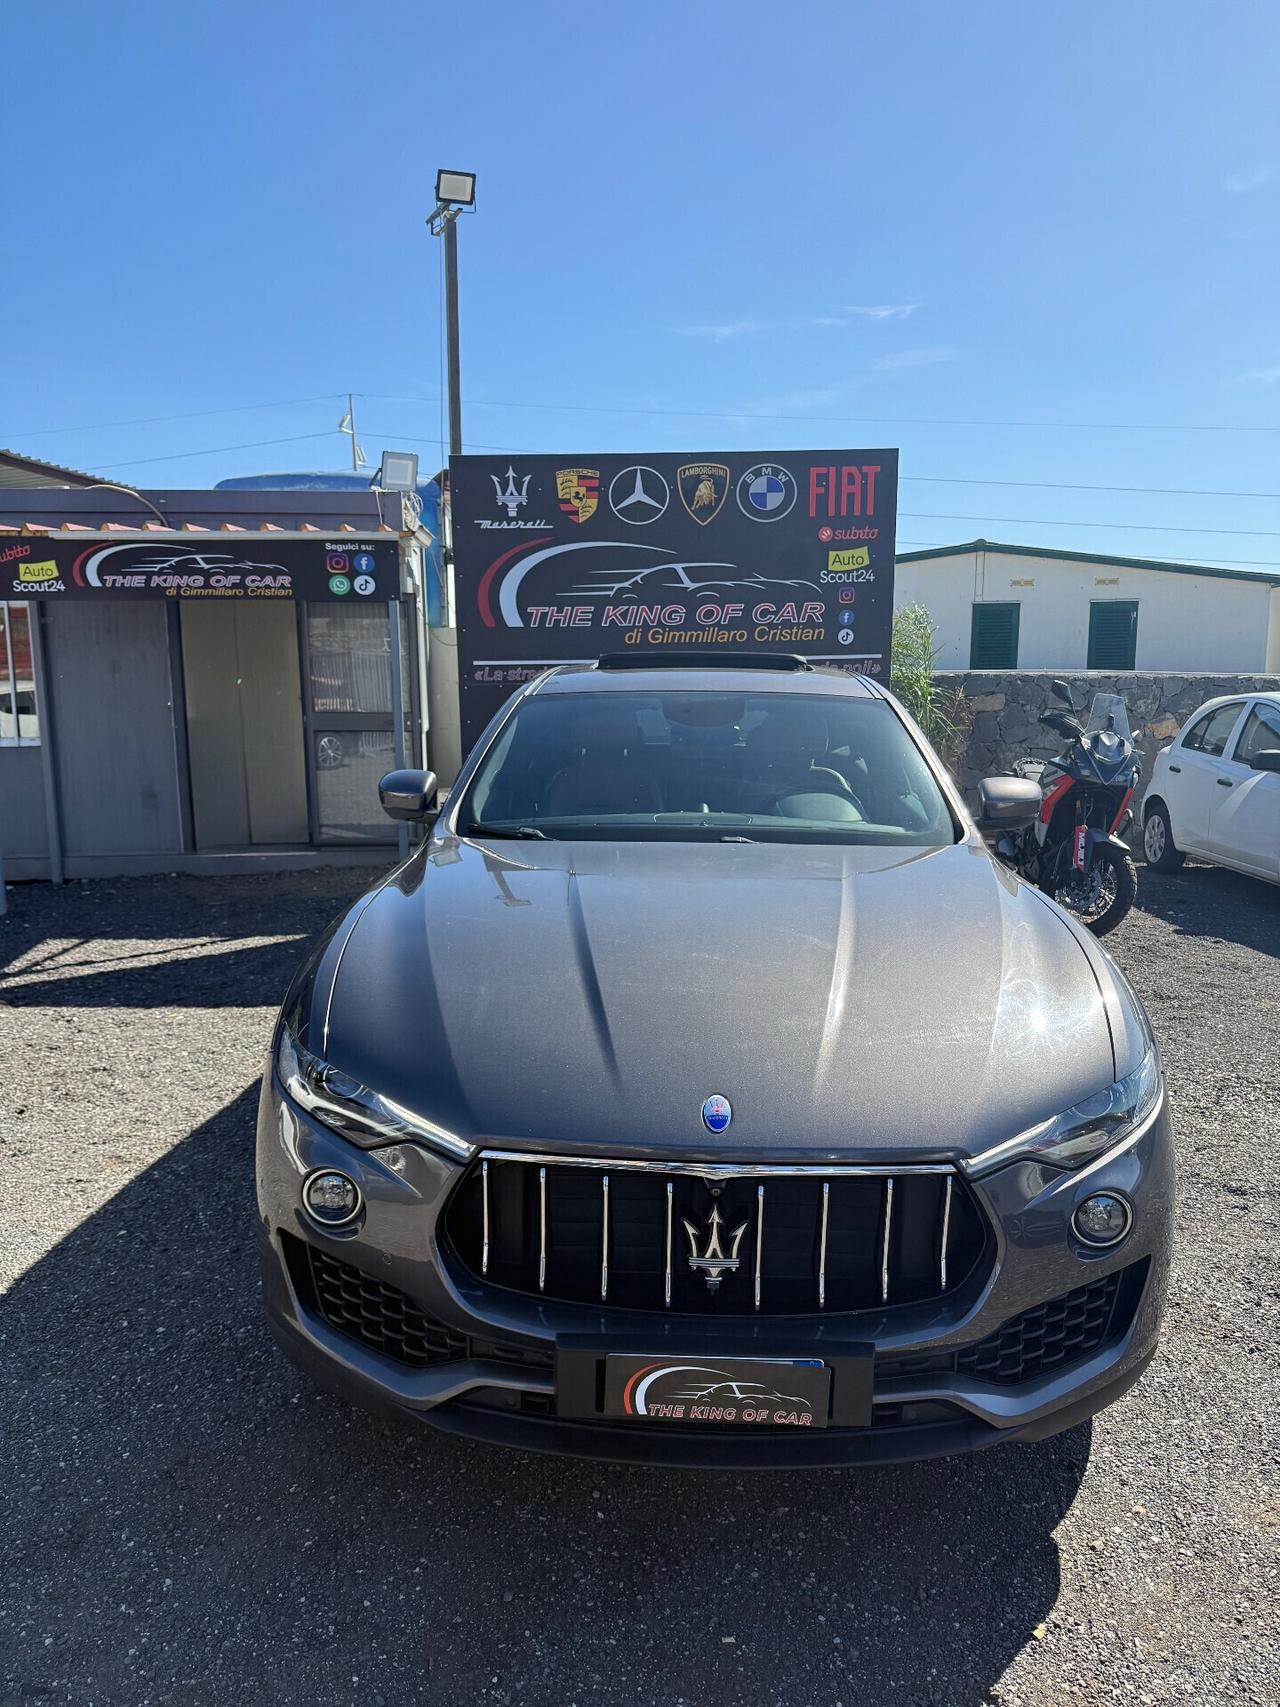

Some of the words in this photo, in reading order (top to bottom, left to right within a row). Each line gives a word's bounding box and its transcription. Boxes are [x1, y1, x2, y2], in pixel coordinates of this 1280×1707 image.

[681, 466, 727, 478] LAMBORGHINI
[745, 467, 789, 484] BMW
[808, 466, 880, 517] FIAT
[0, 545, 30, 562] ubito
[325, 542, 359, 552] Seguici
[831, 553, 865, 566] Auto
[23, 566, 54, 577] Auto
[820, 569, 876, 583] Scout24
[12, 580, 66, 592] Scout24
[103, 575, 147, 587] THE
[150, 575, 205, 587] KING
[209, 575, 241, 587] OF
[245, 575, 292, 587] CAR
[166, 587, 176, 596] di
[180, 586, 244, 596] Gimmillaro
[247, 586, 292, 596] Cristian
[527, 606, 595, 627] THE
[601, 604, 686, 626] KING
[695, 603, 744, 625] OF
[751, 602, 826, 623] CAR
[624, 628, 641, 644] di
[648, 627, 747, 644] Gimmillaro
[754, 625, 825, 642] Cristian
[649, 1404, 685, 1418] THE
[690, 1406, 737, 1420] KING
[742, 1409, 769, 1422] OF
[773, 1411, 813, 1425] CAR
